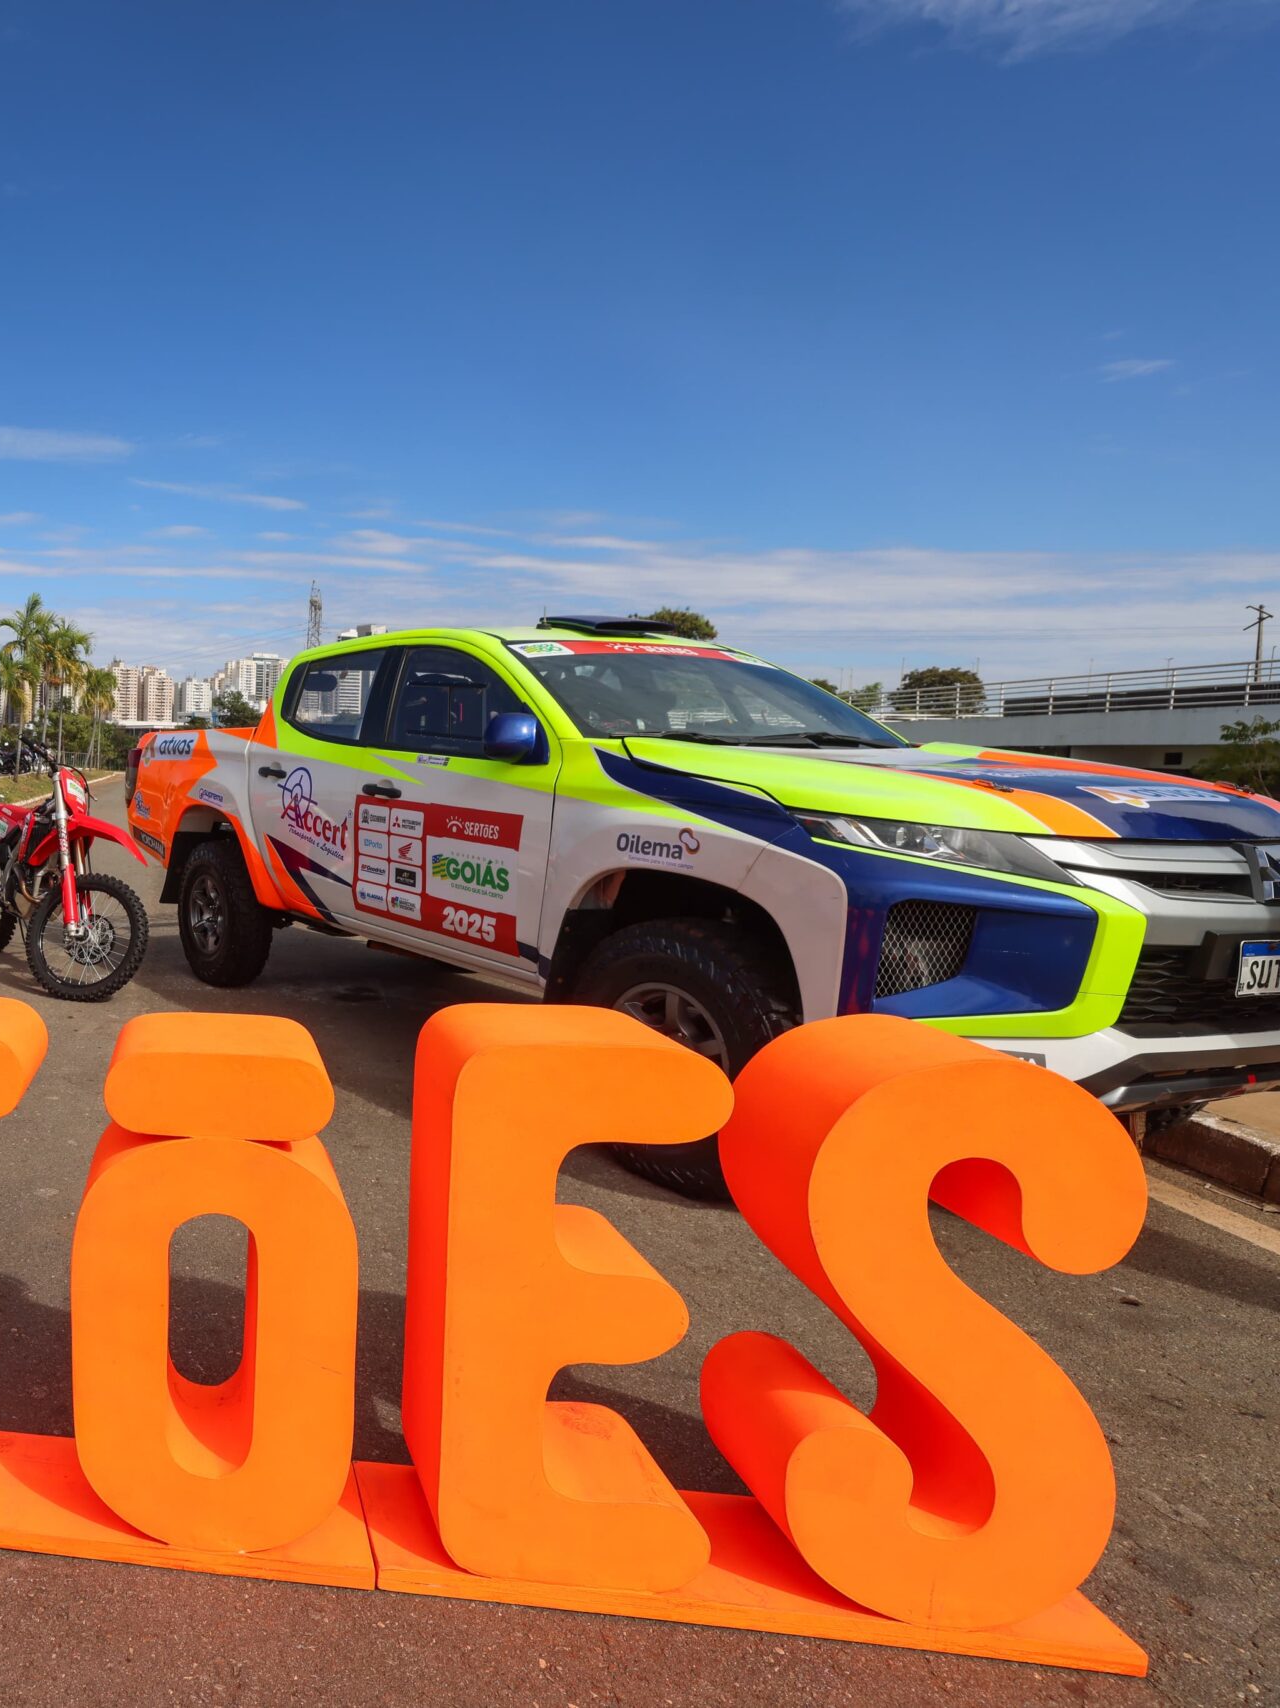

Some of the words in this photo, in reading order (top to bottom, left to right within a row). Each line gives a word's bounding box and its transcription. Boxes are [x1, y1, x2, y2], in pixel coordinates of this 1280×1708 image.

[159, 737, 194, 755] atvos
[281, 793, 348, 851] Accert
[616, 832, 683, 860] Oilema
[446, 858, 510, 892] GOIÁS
[442, 906, 497, 942] 2025
